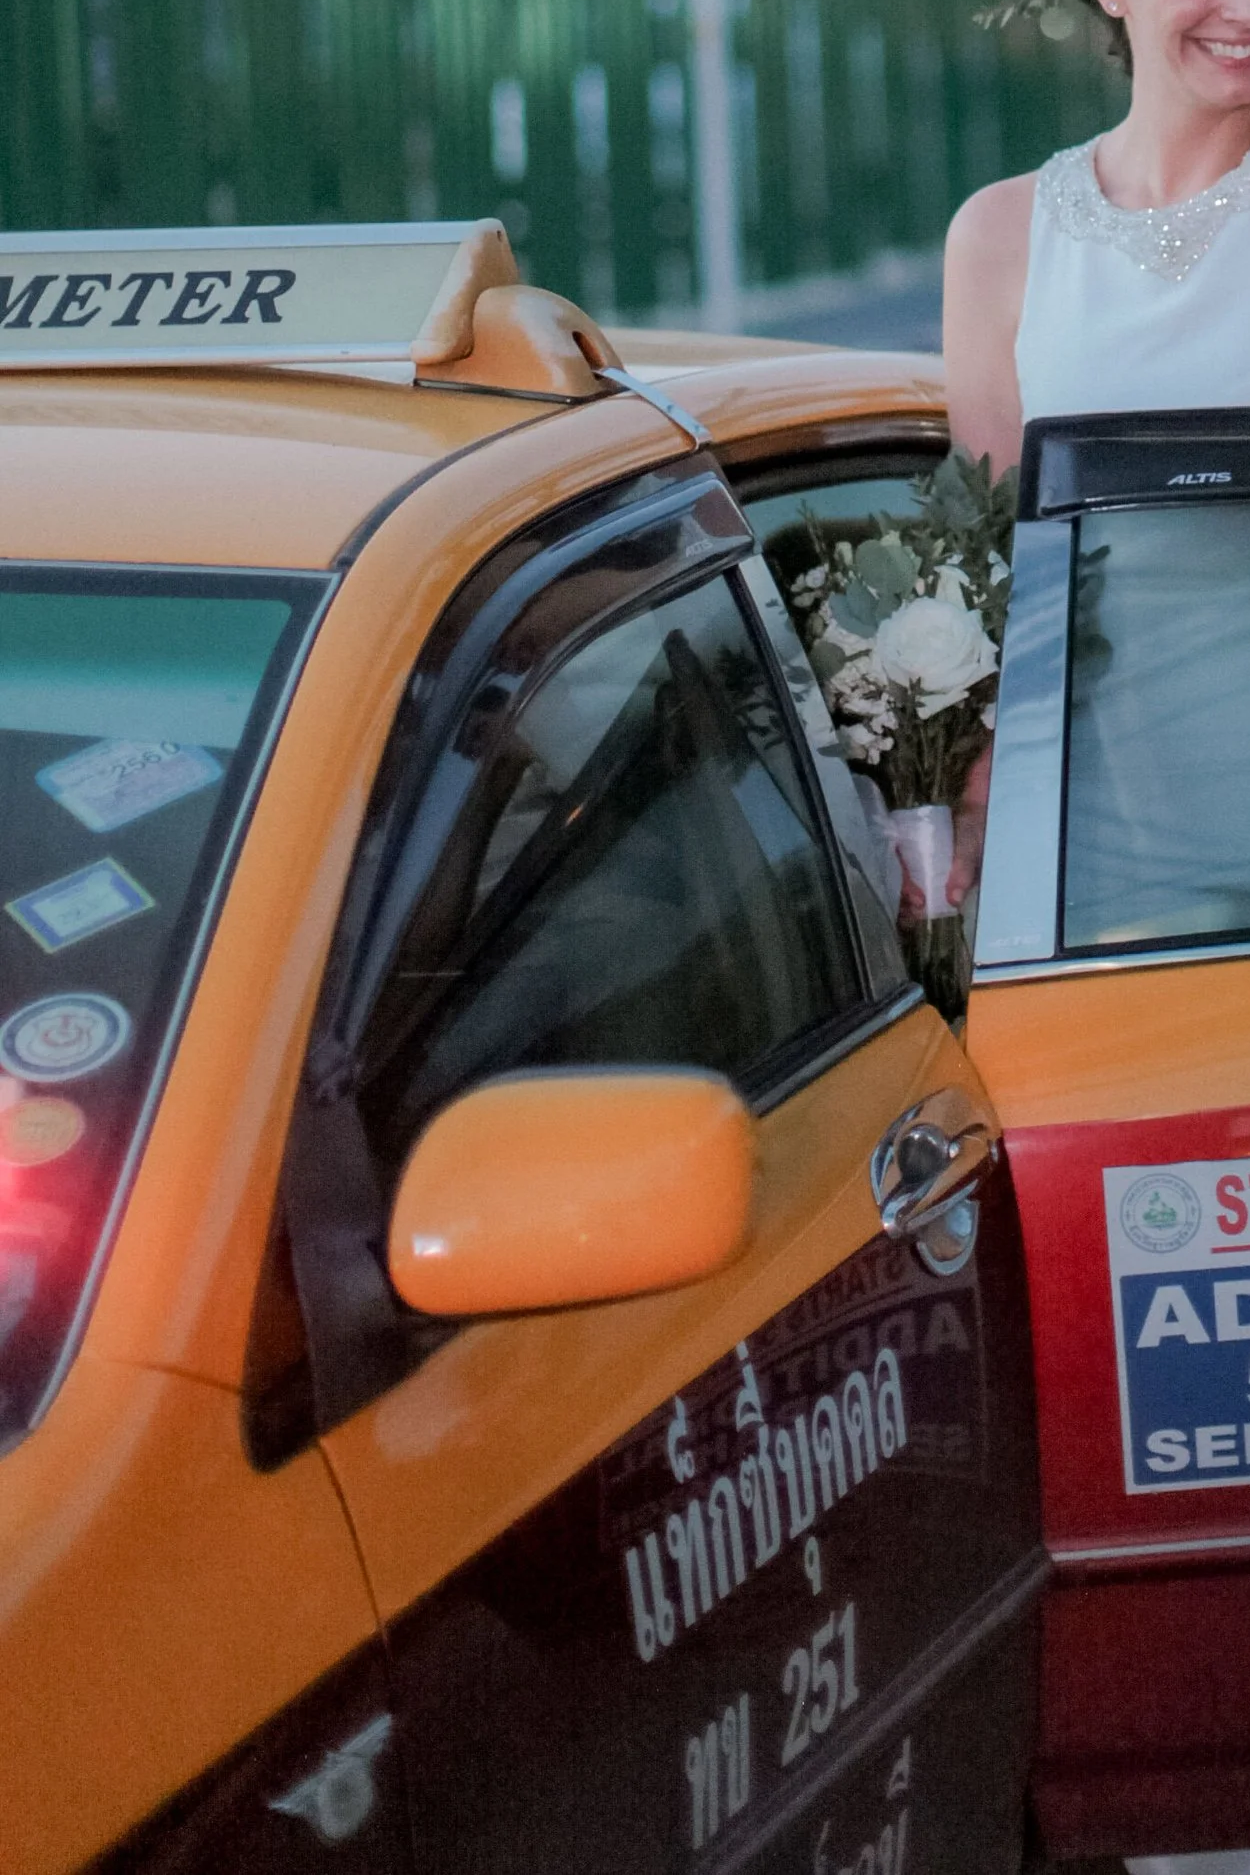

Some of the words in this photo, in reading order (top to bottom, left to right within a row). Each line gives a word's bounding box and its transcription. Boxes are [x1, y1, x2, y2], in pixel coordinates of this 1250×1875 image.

[0, 269, 297, 329] METER
[1166, 471, 1232, 486] ALTIS
[781, 1602, 860, 1768] 251
